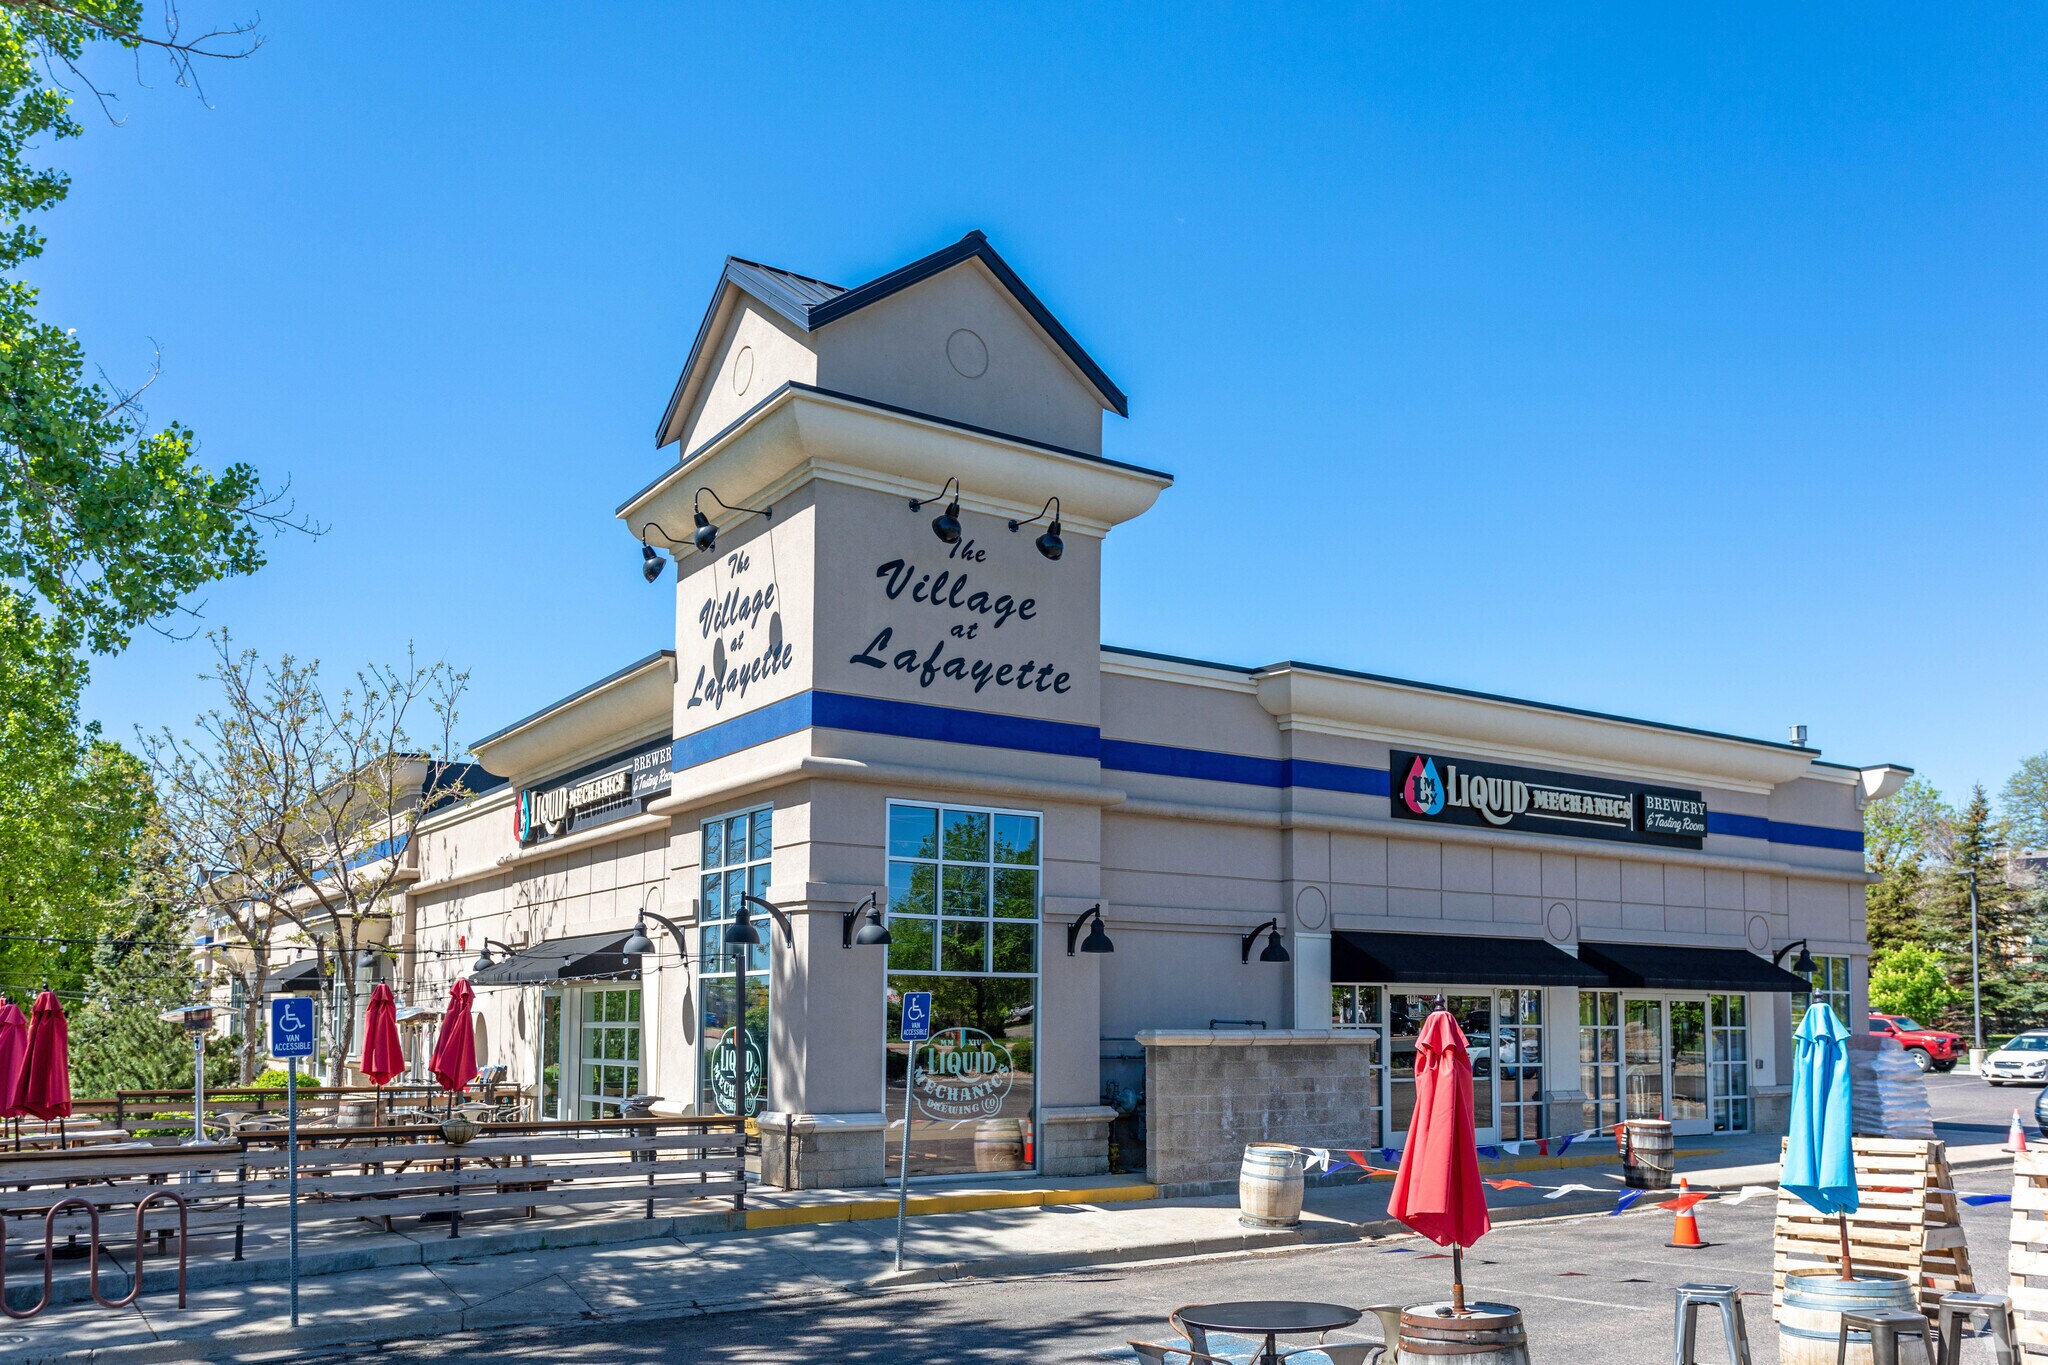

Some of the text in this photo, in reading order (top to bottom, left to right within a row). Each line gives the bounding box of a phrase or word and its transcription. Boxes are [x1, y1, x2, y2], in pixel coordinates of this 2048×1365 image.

[727, 550, 750, 579] The
[876, 558, 1037, 629] Village
[699, 583, 774, 639] Village
[730, 630, 745, 652] at
[950, 621, 978, 641] at
[850, 626, 1072, 694] Lafayette
[687, 640, 793, 711] Lafayette
[633, 745, 673, 773] BREWER
[529, 787, 568, 835] LIQUID
[568, 772, 626, 809] MECHANICS
[1446, 765, 1632, 826] LIQUID MECHANICS
[1646, 795, 1706, 816] BREWERY
[1654, 813, 1682, 833] Tasting
[1682, 816, 1706, 832] Room
[274, 1041, 311, 1051] ACCESSIBLE
[286, 1034, 300, 1042] VAN
[903, 1028, 928, 1036] ACCESSIBLE
[720, 1045, 753, 1078] LIQD
[927, 1048, 997, 1083] LIQUID
[914, 1063, 1009, 1102] MECHANICS
[926, 1097, 980, 1115] BREWING
